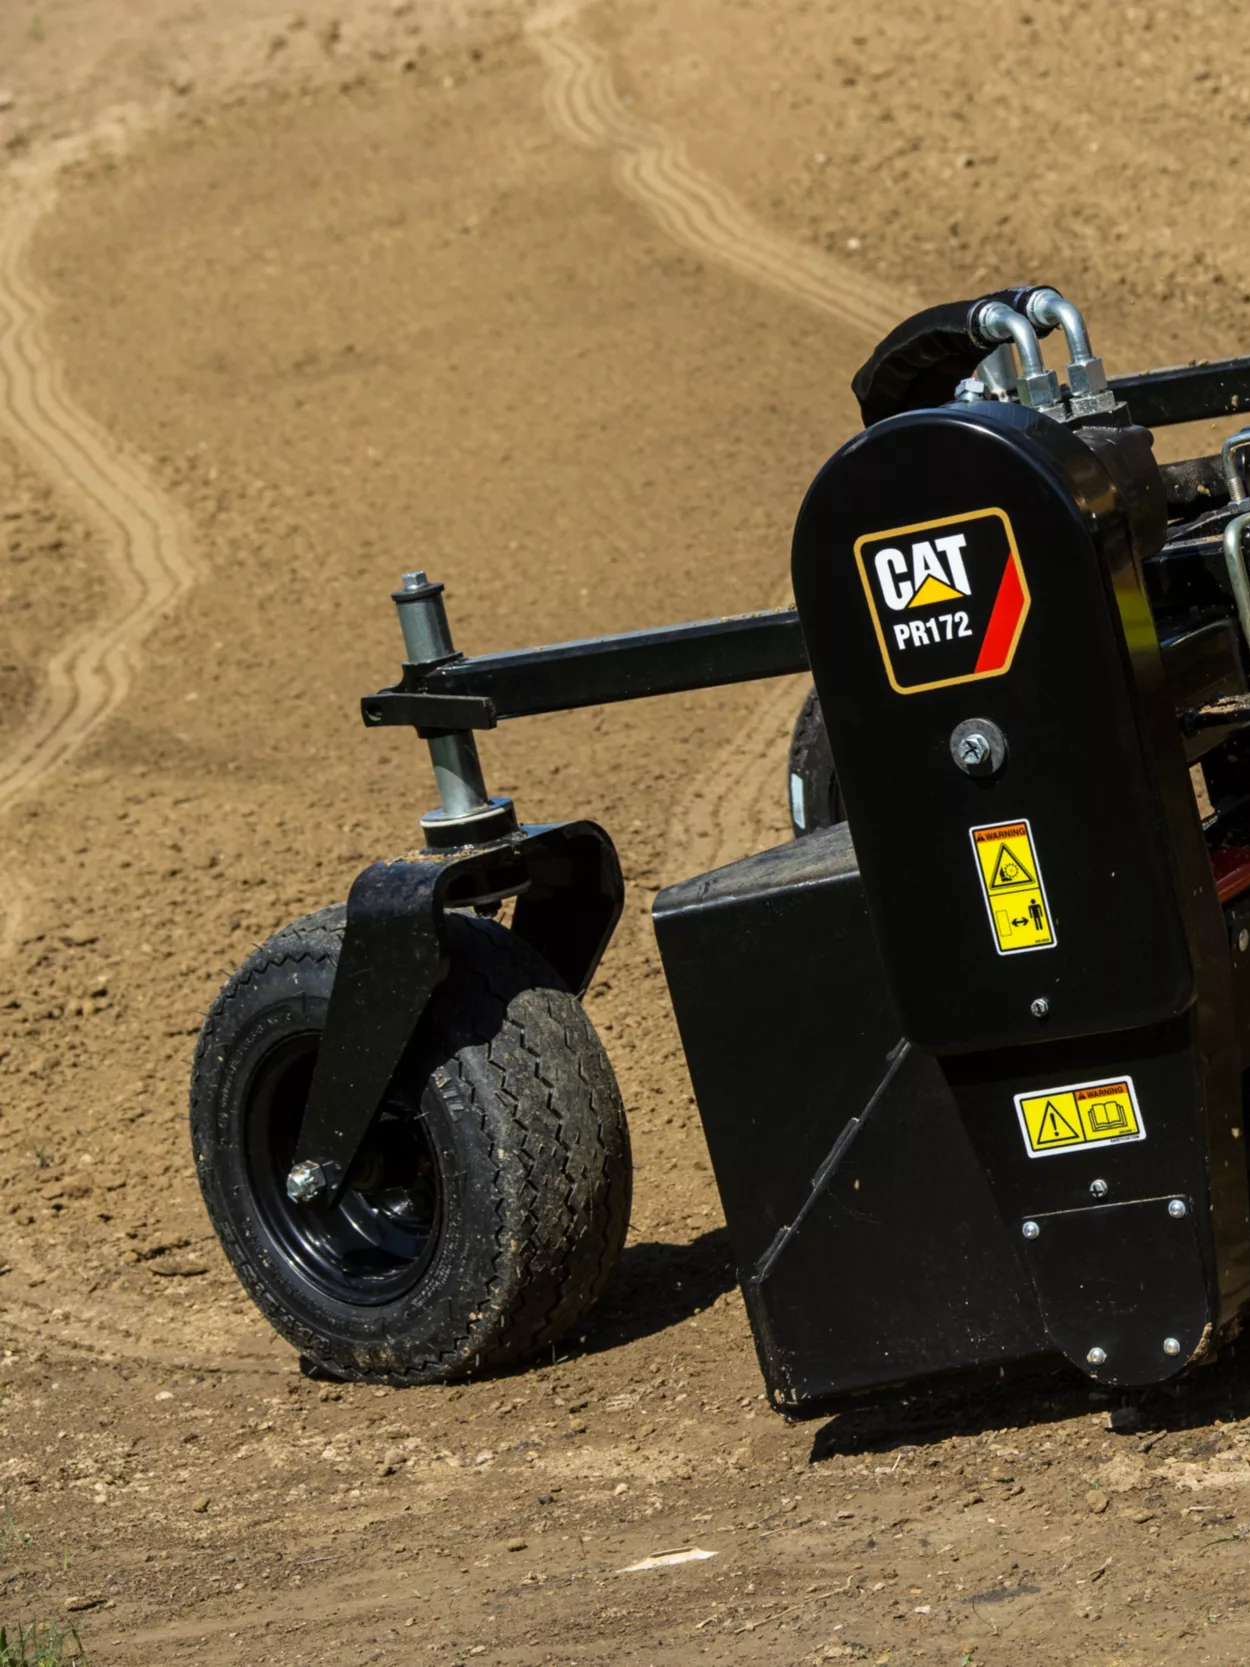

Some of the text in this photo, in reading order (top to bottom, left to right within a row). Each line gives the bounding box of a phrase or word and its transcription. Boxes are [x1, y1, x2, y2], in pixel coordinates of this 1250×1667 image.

[874, 533, 972, 611] CAT
[893, 611, 973, 650] PR172
[985, 827, 1026, 841] WARNING
[1087, 1086, 1124, 1099] WARNING
